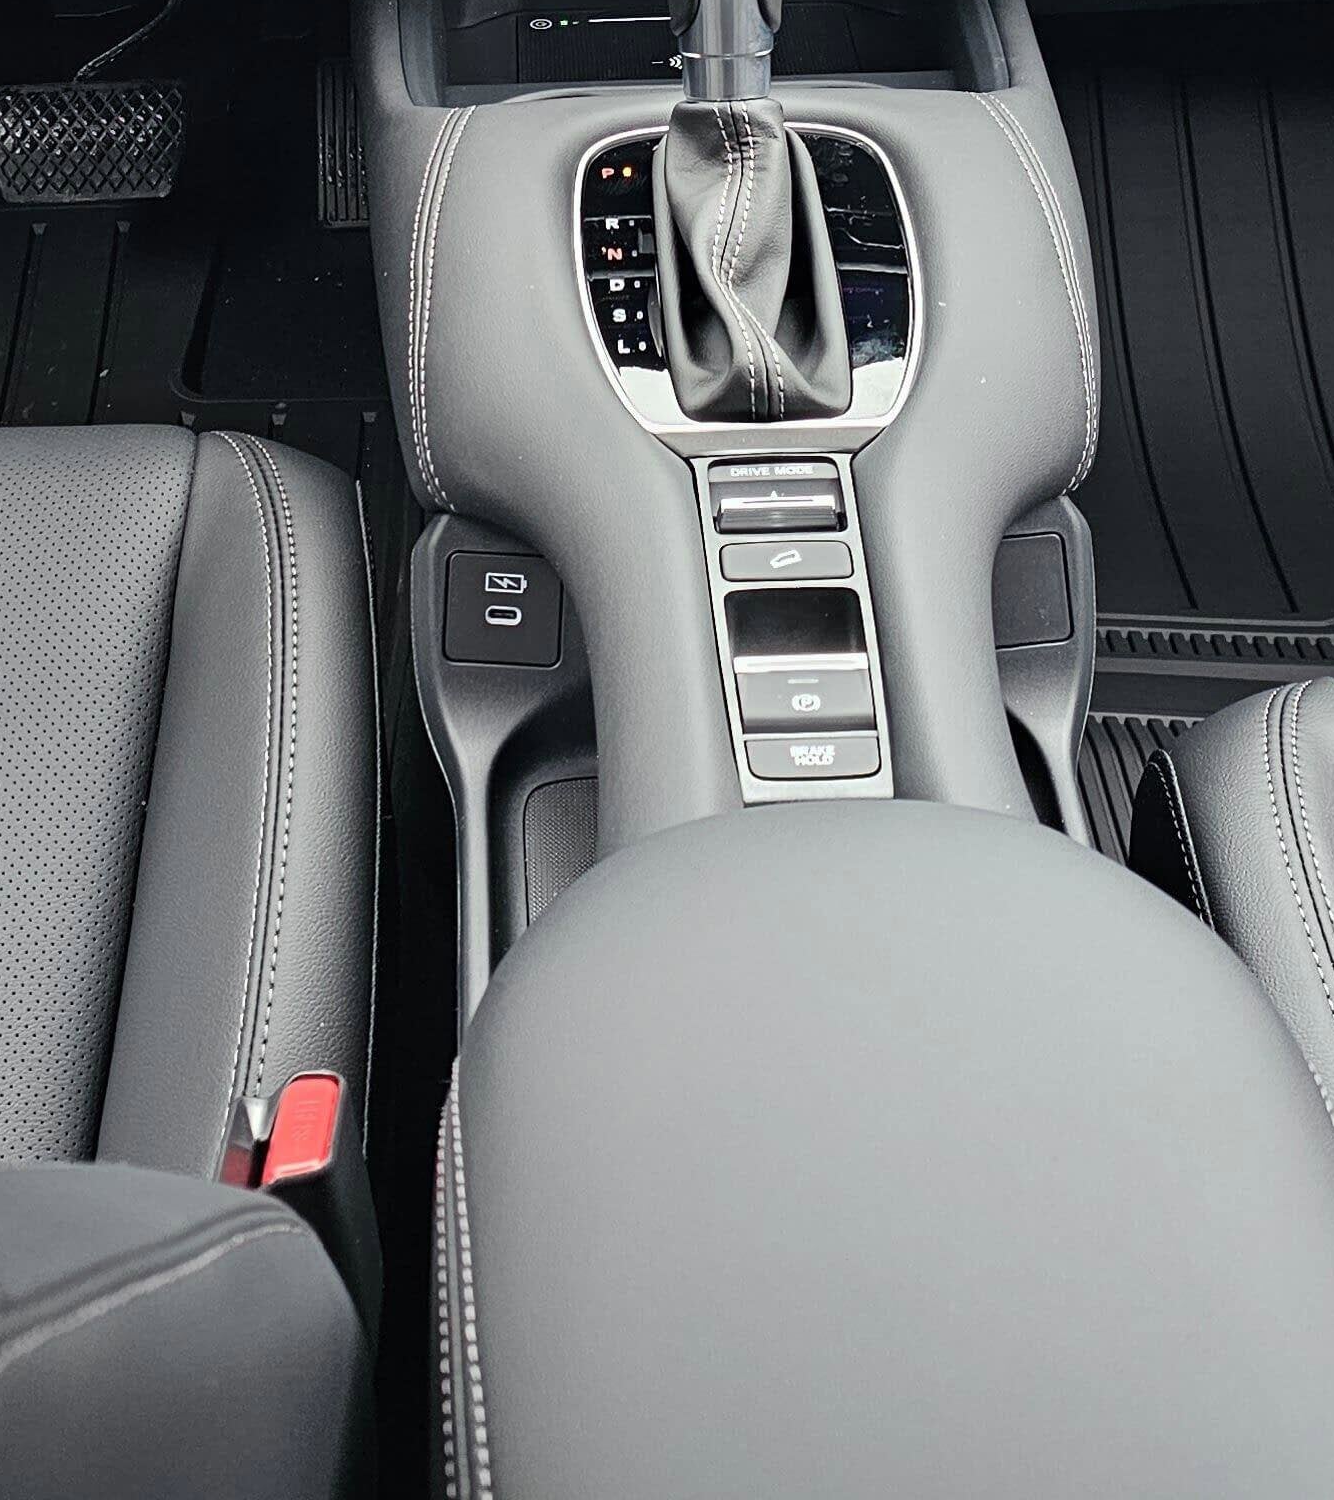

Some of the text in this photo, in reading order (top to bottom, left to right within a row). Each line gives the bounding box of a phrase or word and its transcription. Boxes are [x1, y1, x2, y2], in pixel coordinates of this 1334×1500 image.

[601, 167, 615, 179] P
[605, 217, 619, 230] R
[608, 248, 623, 260] N
[609, 278, 625, 291] D
[612, 308, 627, 322] S
[617, 339, 631, 354] L
[730, 465, 814, 477] DRIVE MODE
[789, 745, 835, 757] BRAKE
[794, 755, 834, 766] HOLD
